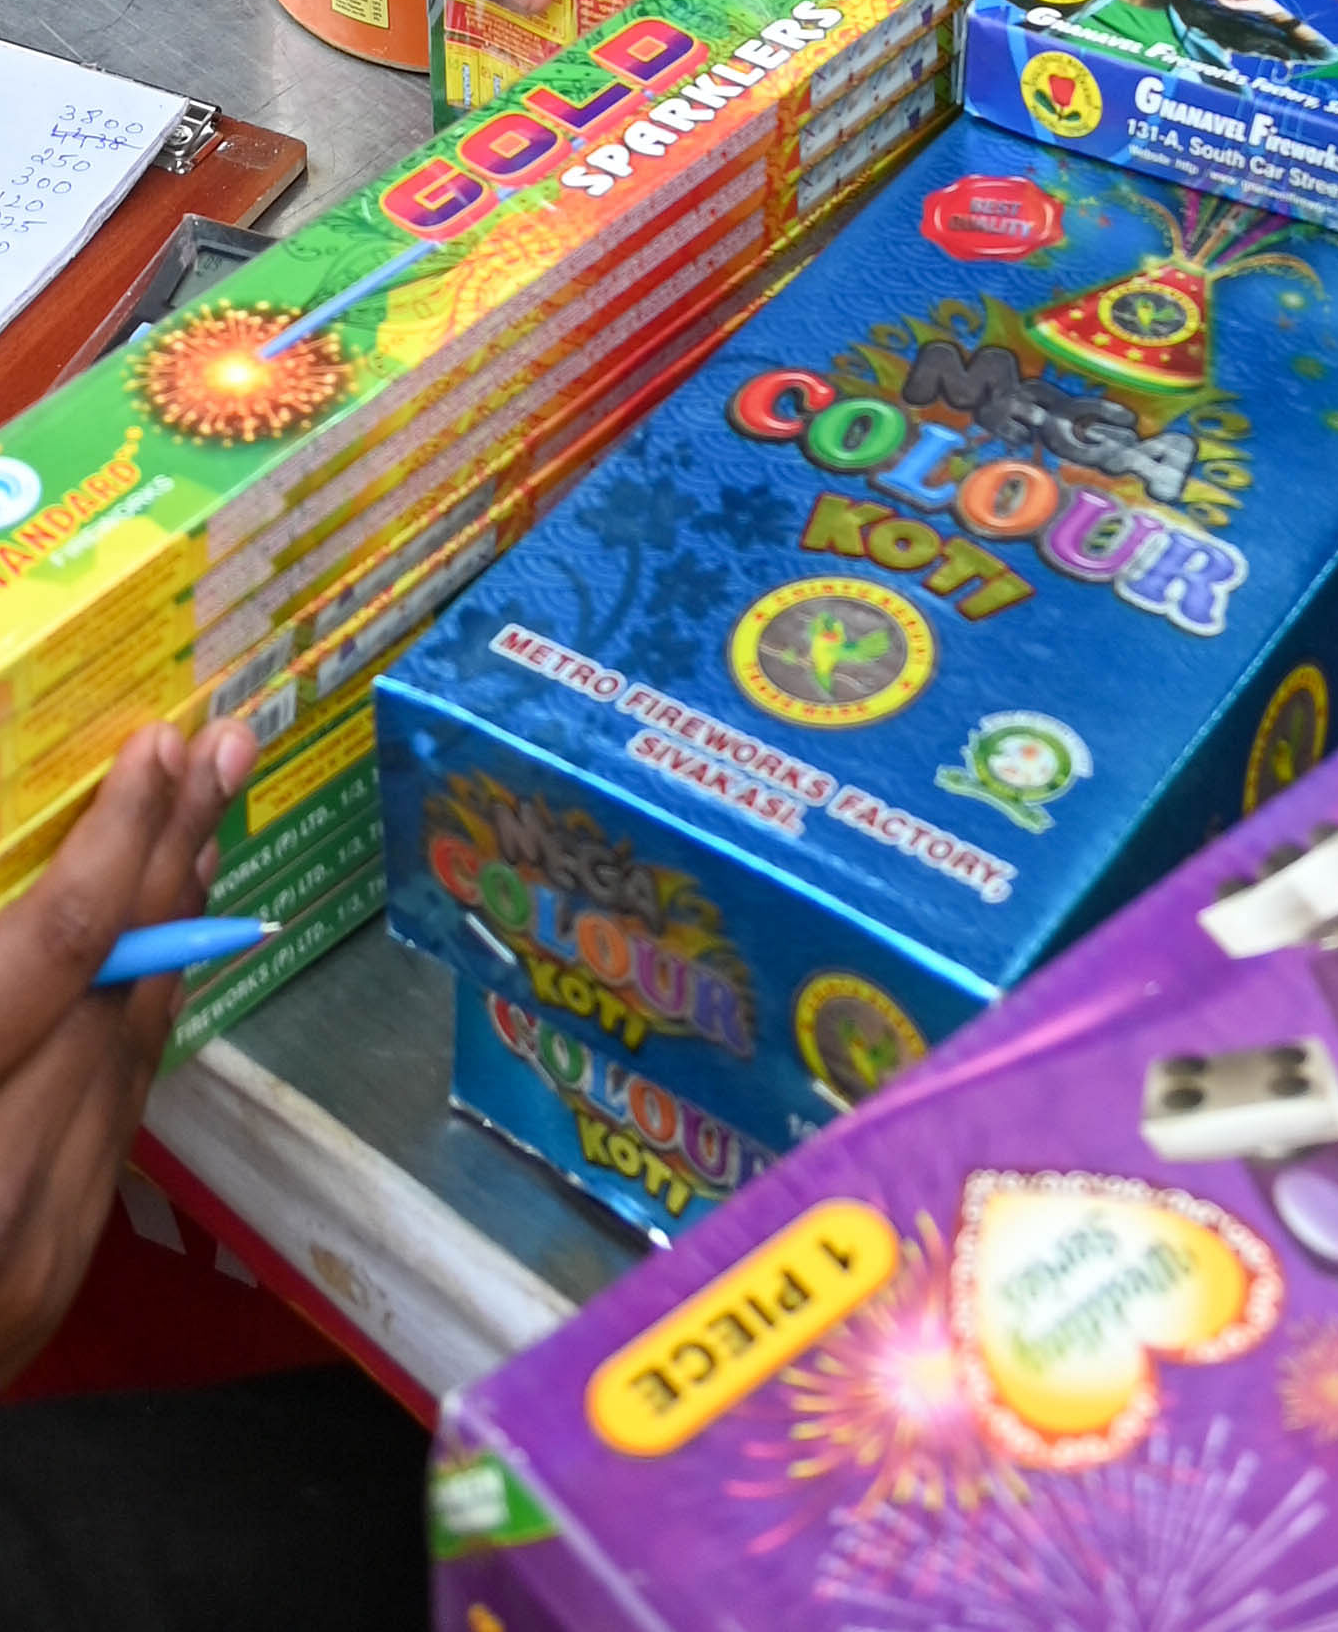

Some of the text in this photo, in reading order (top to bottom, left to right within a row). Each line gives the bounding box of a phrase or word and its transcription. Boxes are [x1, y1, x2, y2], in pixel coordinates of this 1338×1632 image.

[57, 103, 145, 136] 3800
[380, 17, 709, 243] GOLD
[560, 0, 845, 197] SPARKLERS
[1134, 76, 1248, 145] GNANAVEL
[11, 166, 73, 195] 300
[30, 147, 92, 173] 250
[969, 195, 1023, 216] BEST
[1188, 137, 1247, 171] South
[1249, 155, 1286, 182] Car
[903, 340, 1200, 505] MEGA
[727, 368, 1249, 637] COLOUR
[802, 492, 1035, 621] KOTI
[493, 626, 623, 700] METRO
[626, 685, 834, 800] FIREWORKS
[212, 844, 273, 902] WORKS
[491, 797, 662, 930] MEGA
[429, 835, 755, 1057] COLOUR
[525, 955, 650, 1051] KOTI
[577, 1113, 693, 1216] KOTI
[628, 1267, 813, 1415] PIECE
